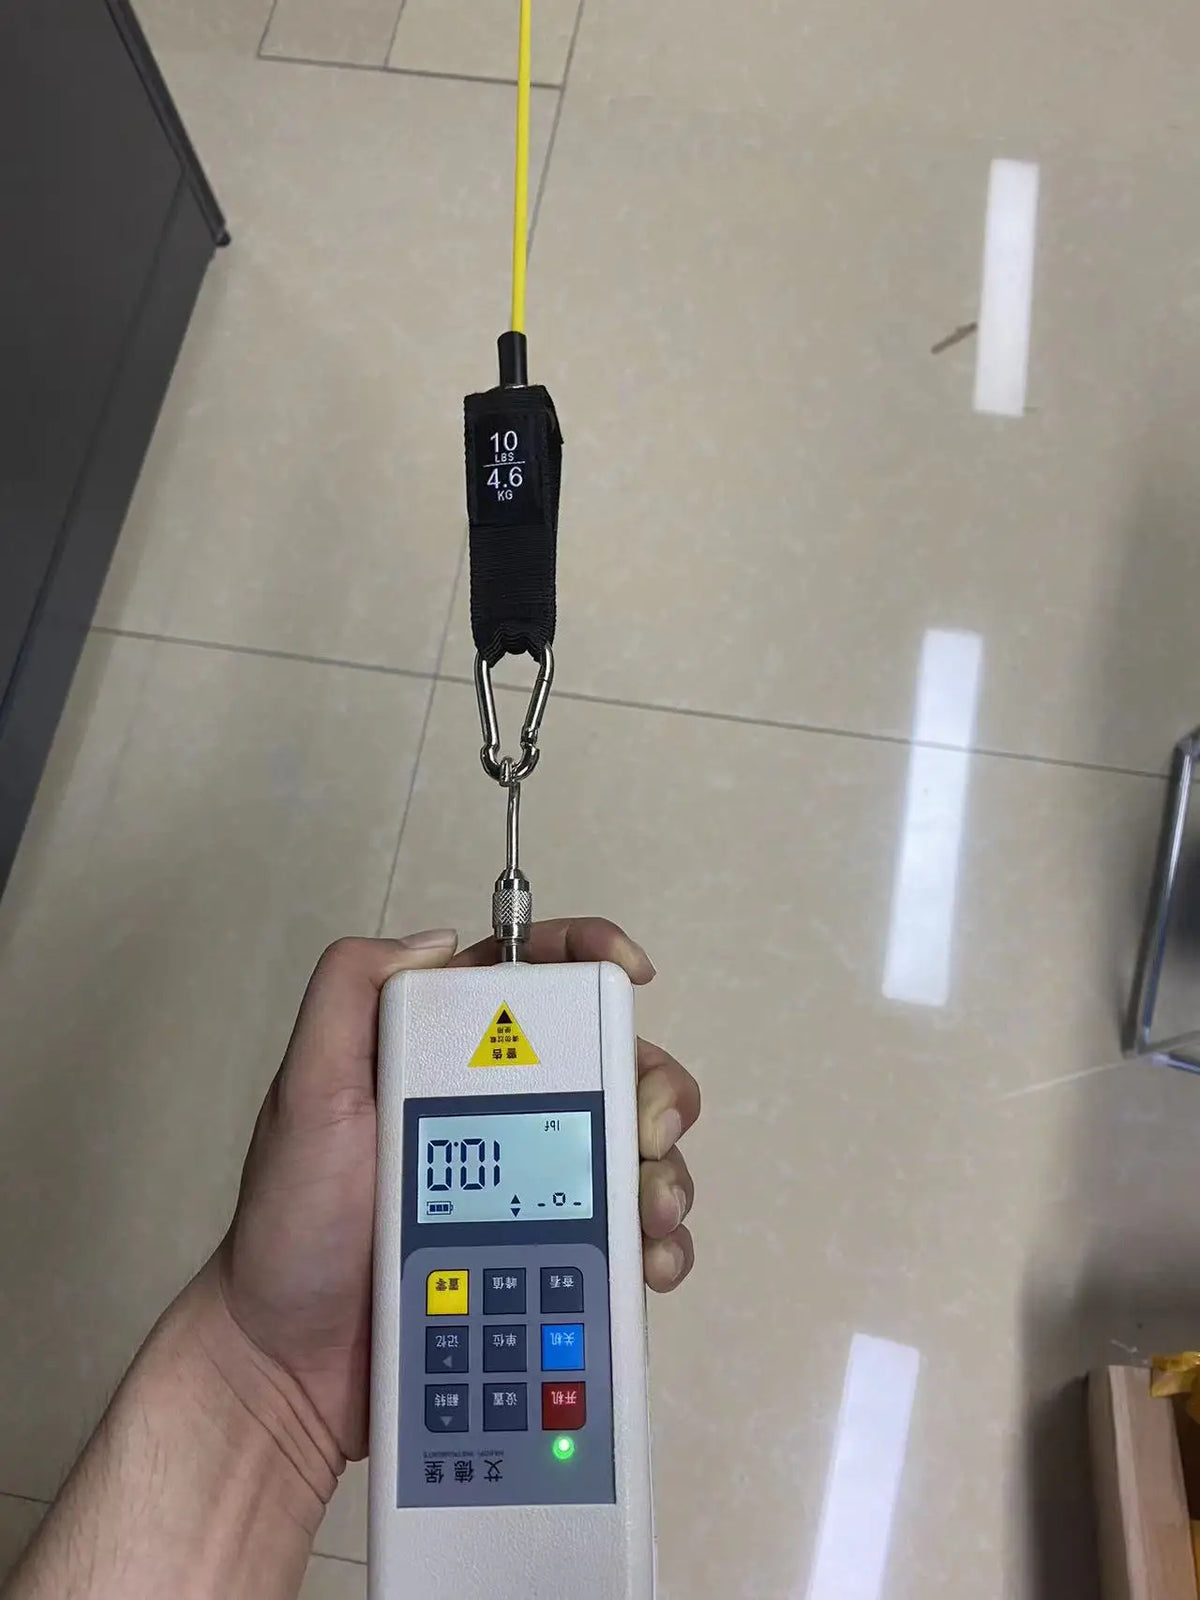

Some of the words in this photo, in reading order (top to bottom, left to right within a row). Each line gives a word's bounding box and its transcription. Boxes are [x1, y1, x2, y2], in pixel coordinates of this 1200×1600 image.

[490, 430, 518, 453] 10
[494, 452, 514, 463] LBS
[486, 466, 523, 489] 4.6
[497, 489, 513, 501] KG
[492, 1048, 517, 1060] 警告
[544, 1119, 560, 1132] lbf
[427, 1138, 501, 1191] 10.0
[435, 1277, 460, 1291] 置零
[492, 1276, 518, 1289] 峰值
[550, 1275, 574, 1288] 查看
[435, 1335, 459, 1348] 记忆
[492, 1333, 518, 1346] 单位
[551, 1332, 575, 1346] 关机
[435, 1393, 459, 1407] 翻转
[493, 1392, 518, 1406] 设置
[551, 1390, 577, 1405] 开机
[424, 1459, 503, 1484] 艾德堡
